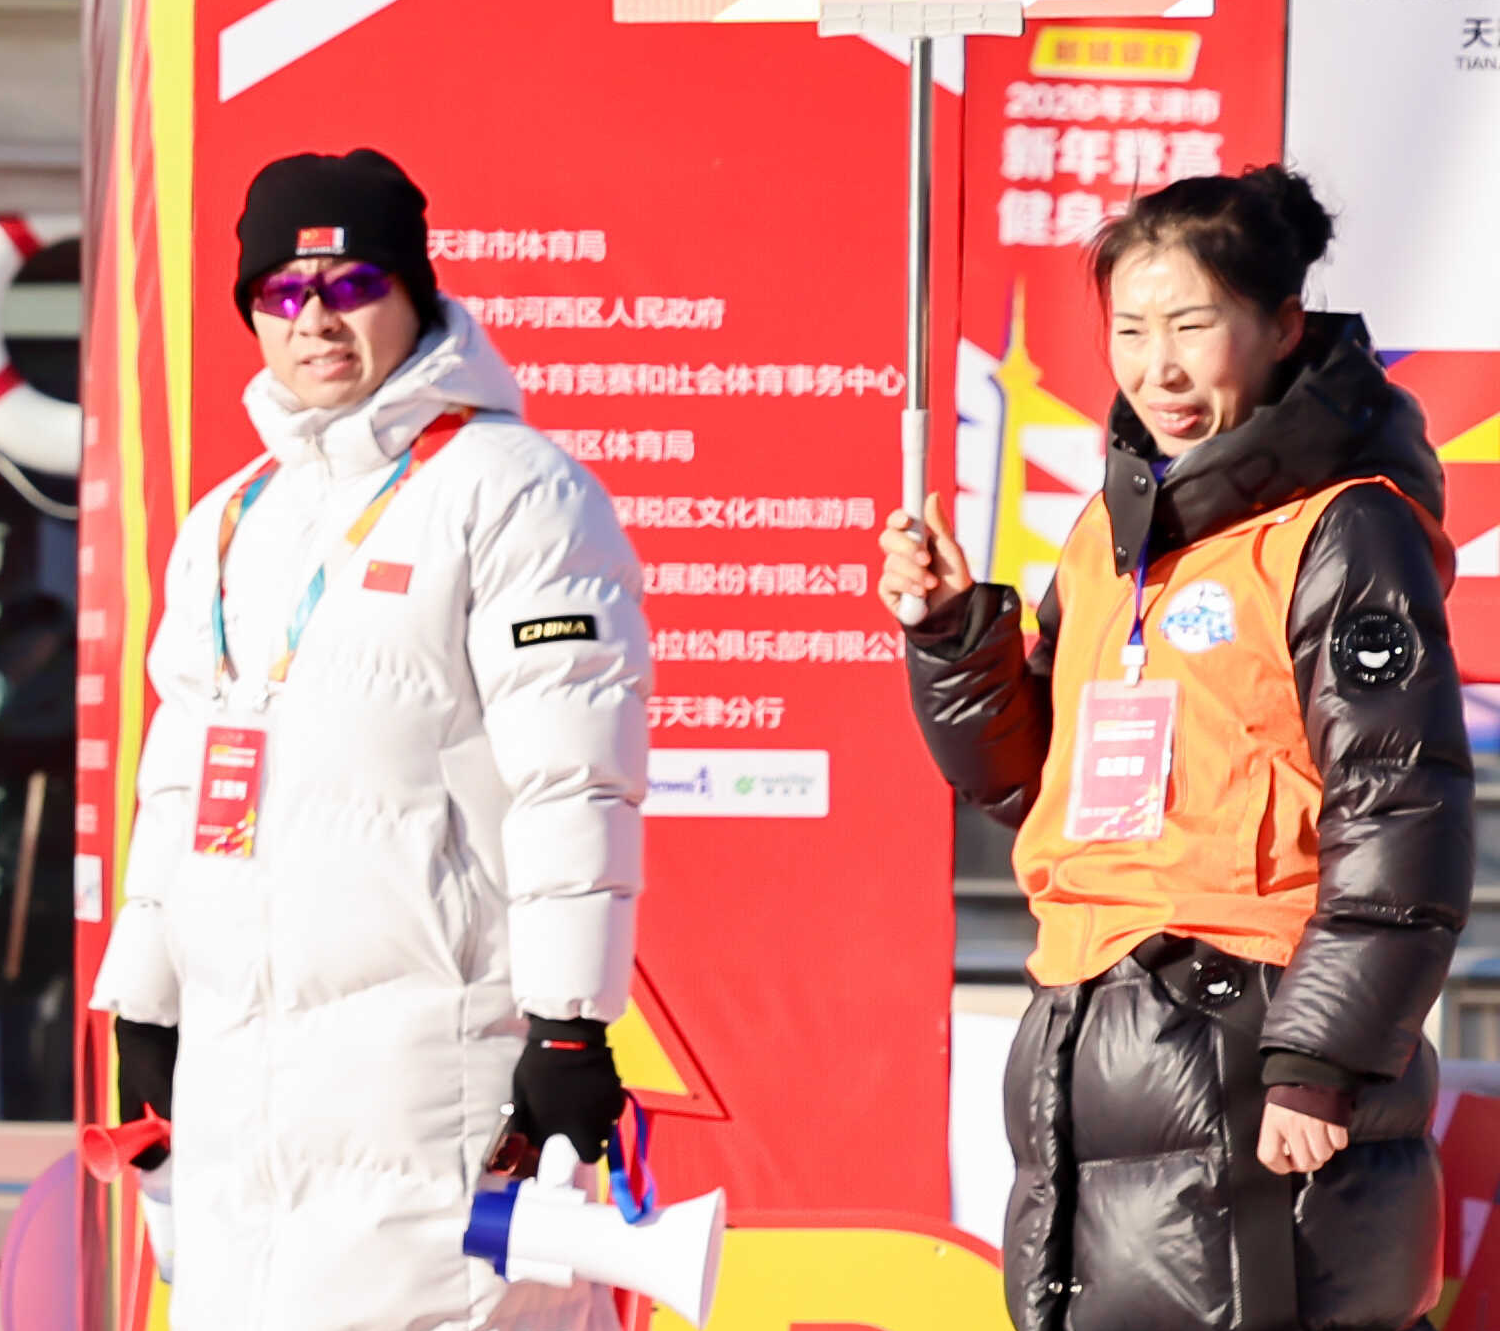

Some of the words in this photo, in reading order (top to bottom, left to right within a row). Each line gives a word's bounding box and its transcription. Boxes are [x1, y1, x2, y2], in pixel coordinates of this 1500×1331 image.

[1462, 17, 1500, 50] 天
[426, 229, 606, 263] 天津市体育局
